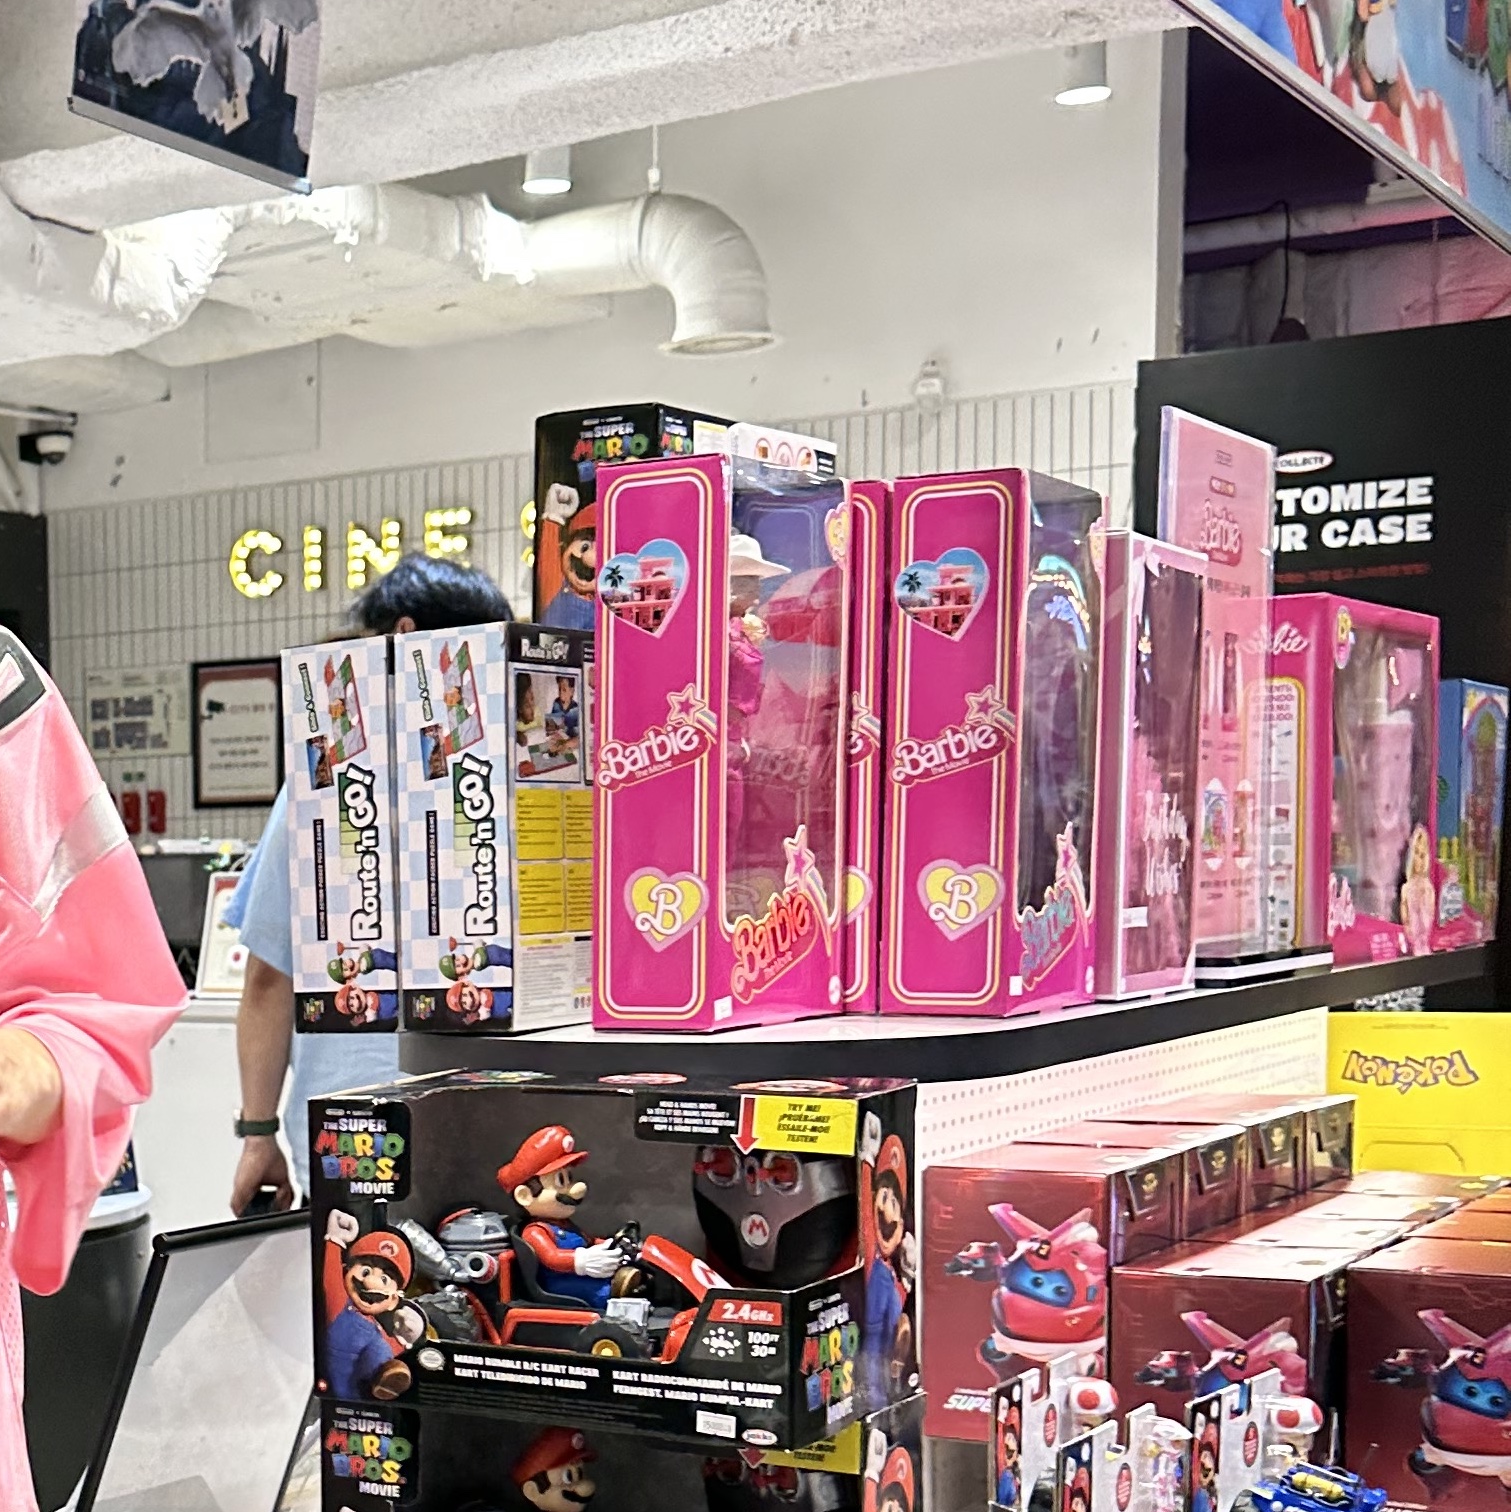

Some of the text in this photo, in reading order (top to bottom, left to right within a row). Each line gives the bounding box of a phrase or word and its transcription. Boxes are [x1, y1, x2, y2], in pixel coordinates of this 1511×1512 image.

[594, 422, 635, 439] SUPER
[570, 433, 650, 461] MARIO
[1273, 477, 1434, 517] TOMIZE
[1321, 513, 1434, 549] CASE
[229, 508, 472, 599] CINE
[598, 724, 701, 786] Barbie
[892, 724, 998, 782] Barbie
[634, 882, 683, 935] B
[928, 874, 978, 924] B
[734, 893, 811, 994] Barbie
[338, 1118, 387, 1132] SUPER
[314, 1130, 405, 1158] MARIO
[321, 1154, 400, 1181] BROS.
[350, 1181, 395, 1195] MOVIE
[800, 1321, 860, 1376] MARIO
[453, 1353, 484, 1366] MARIO
[541, 1363, 567, 1375] KART
[568, 1366, 600, 1378] RACER
[454, 1367, 480, 1379] KART
[554, 1378, 587, 1390] MARIO
[612, 1370, 640, 1382] KART
[745, 1382, 782, 1395] MARIO
[348, 1417, 394, 1436] SUPER
[325, 1428, 414, 1462] MARIO
[358, 1480, 401, 1498] MOVIE
